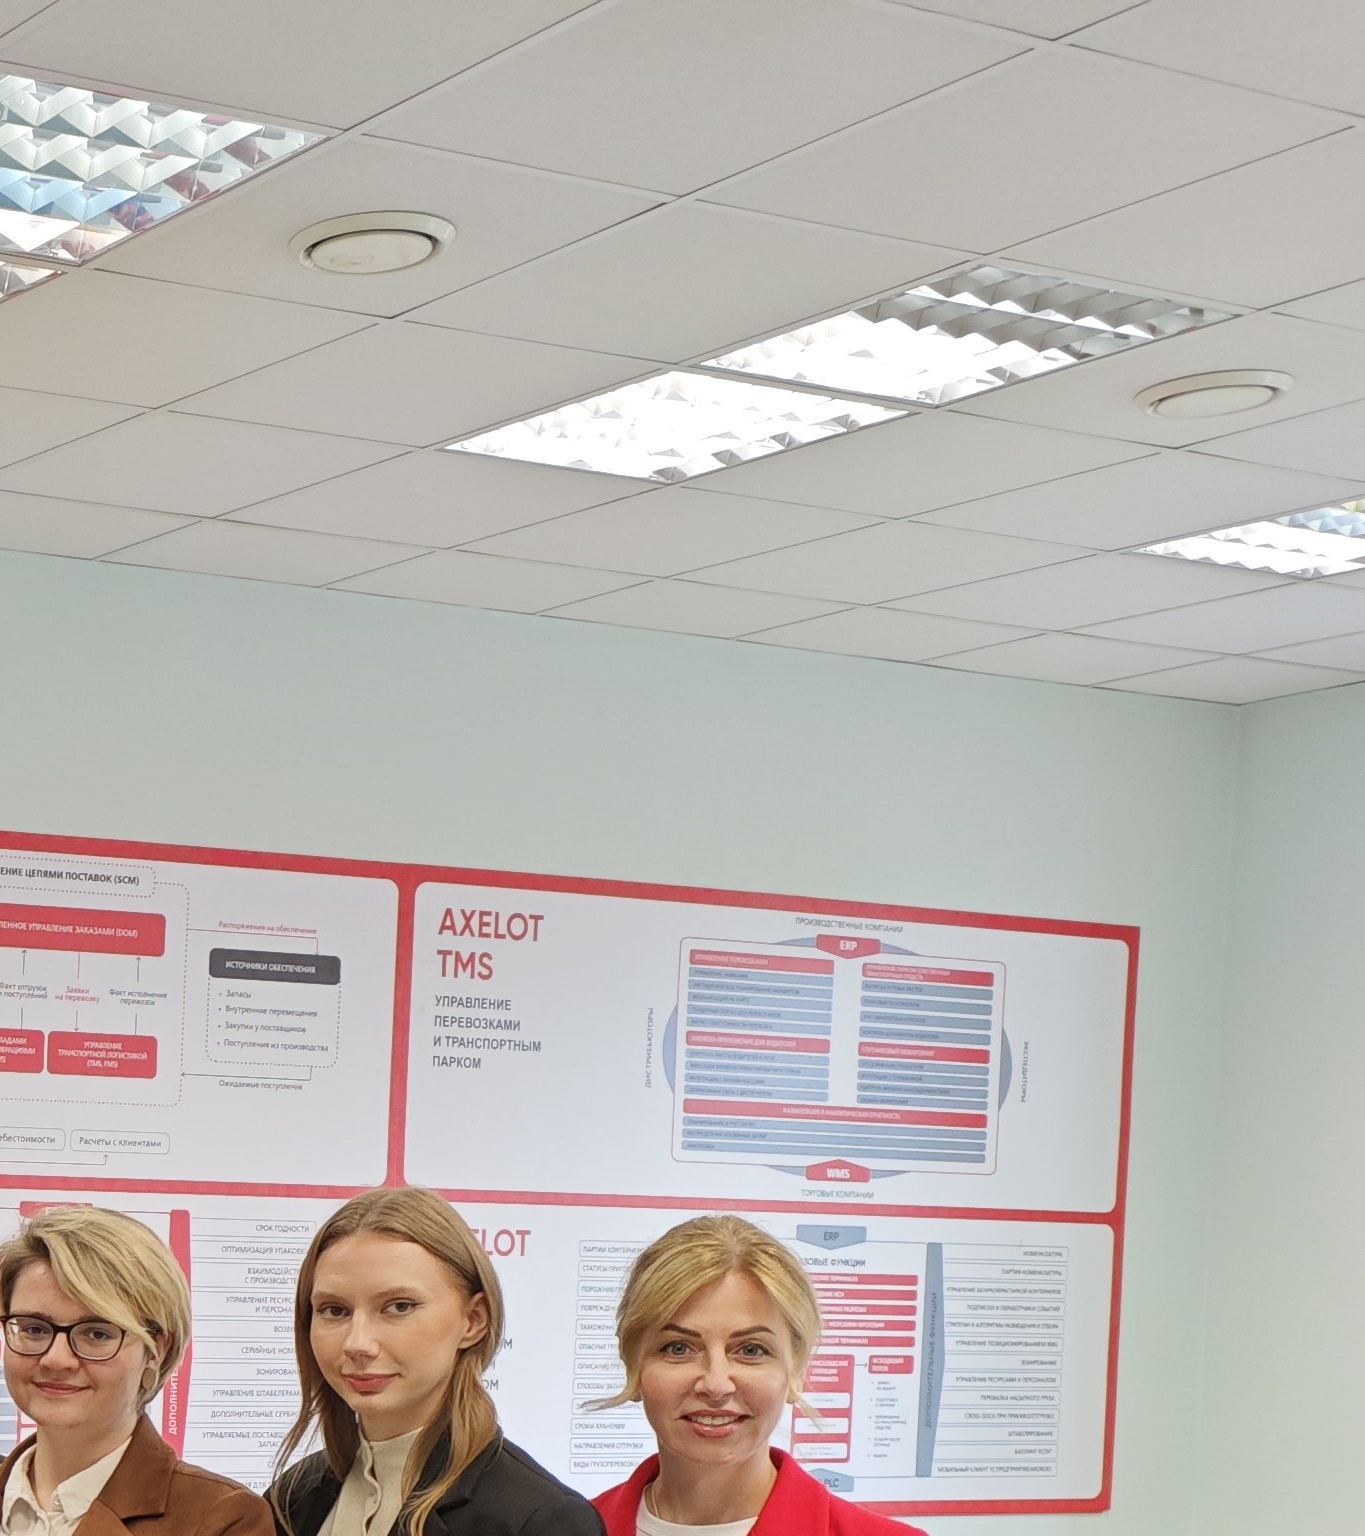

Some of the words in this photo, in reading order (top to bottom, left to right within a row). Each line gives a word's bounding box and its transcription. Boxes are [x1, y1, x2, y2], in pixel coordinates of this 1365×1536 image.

[25, 868, 63, 880] ЦЕПЯМИ
[66, 872, 112, 883] ПОСТАВОК
[114, 874, 140, 887] (SCM)
[29, 922, 73, 933] УПРАВЛЕНИЕ
[75, 925, 114, 936] ЗАКАЗАМИ
[438, 908, 544, 941] AXELOT
[840, 940, 857, 950] ERP
[437, 949, 493, 980] TMS
[435, 995, 511, 1011] УПРАВЛЕНИЕ
[434, 1015, 520, 1031] ПЕРЕВОЗКАМИ
[433, 1036, 441, 1047] И
[445, 1036, 541, 1052] ТРАНСПОРТНЫМ
[433, 1056, 481, 1069] ПАРКОМ
[79, 1136, 110, 1147] Расчеты
[827, 1168, 850, 1179] WMS
[824, 1231, 839, 1241] ERP
[169, 1368, 178, 1435] ДОПОЛНИТЕ
